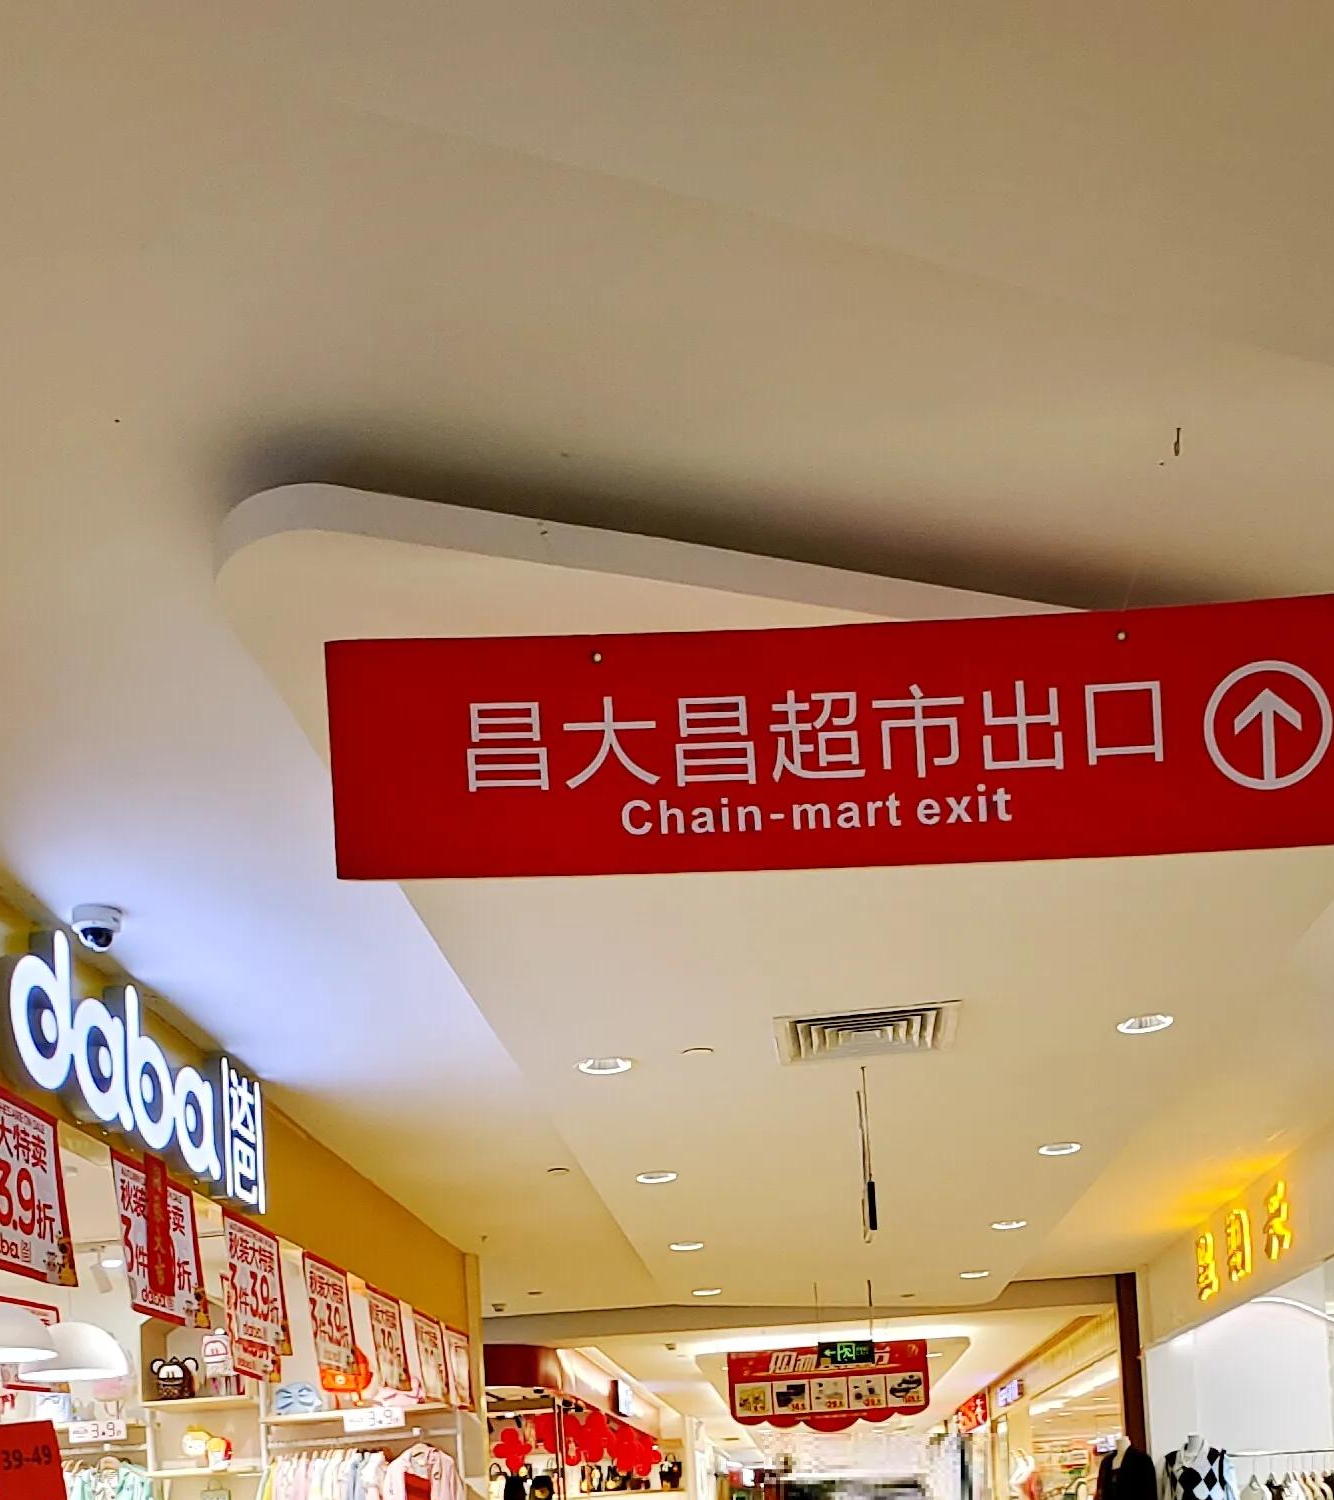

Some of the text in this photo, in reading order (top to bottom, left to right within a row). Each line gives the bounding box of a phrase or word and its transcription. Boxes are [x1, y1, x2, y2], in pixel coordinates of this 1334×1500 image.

[467, 679, 1164, 792] 昌大昌超市出口
[621, 785, 1012, 836] Chain-mart exit
[10, 929, 223, 1181] daba
[2, 1444, 53, 1471] 39-49
